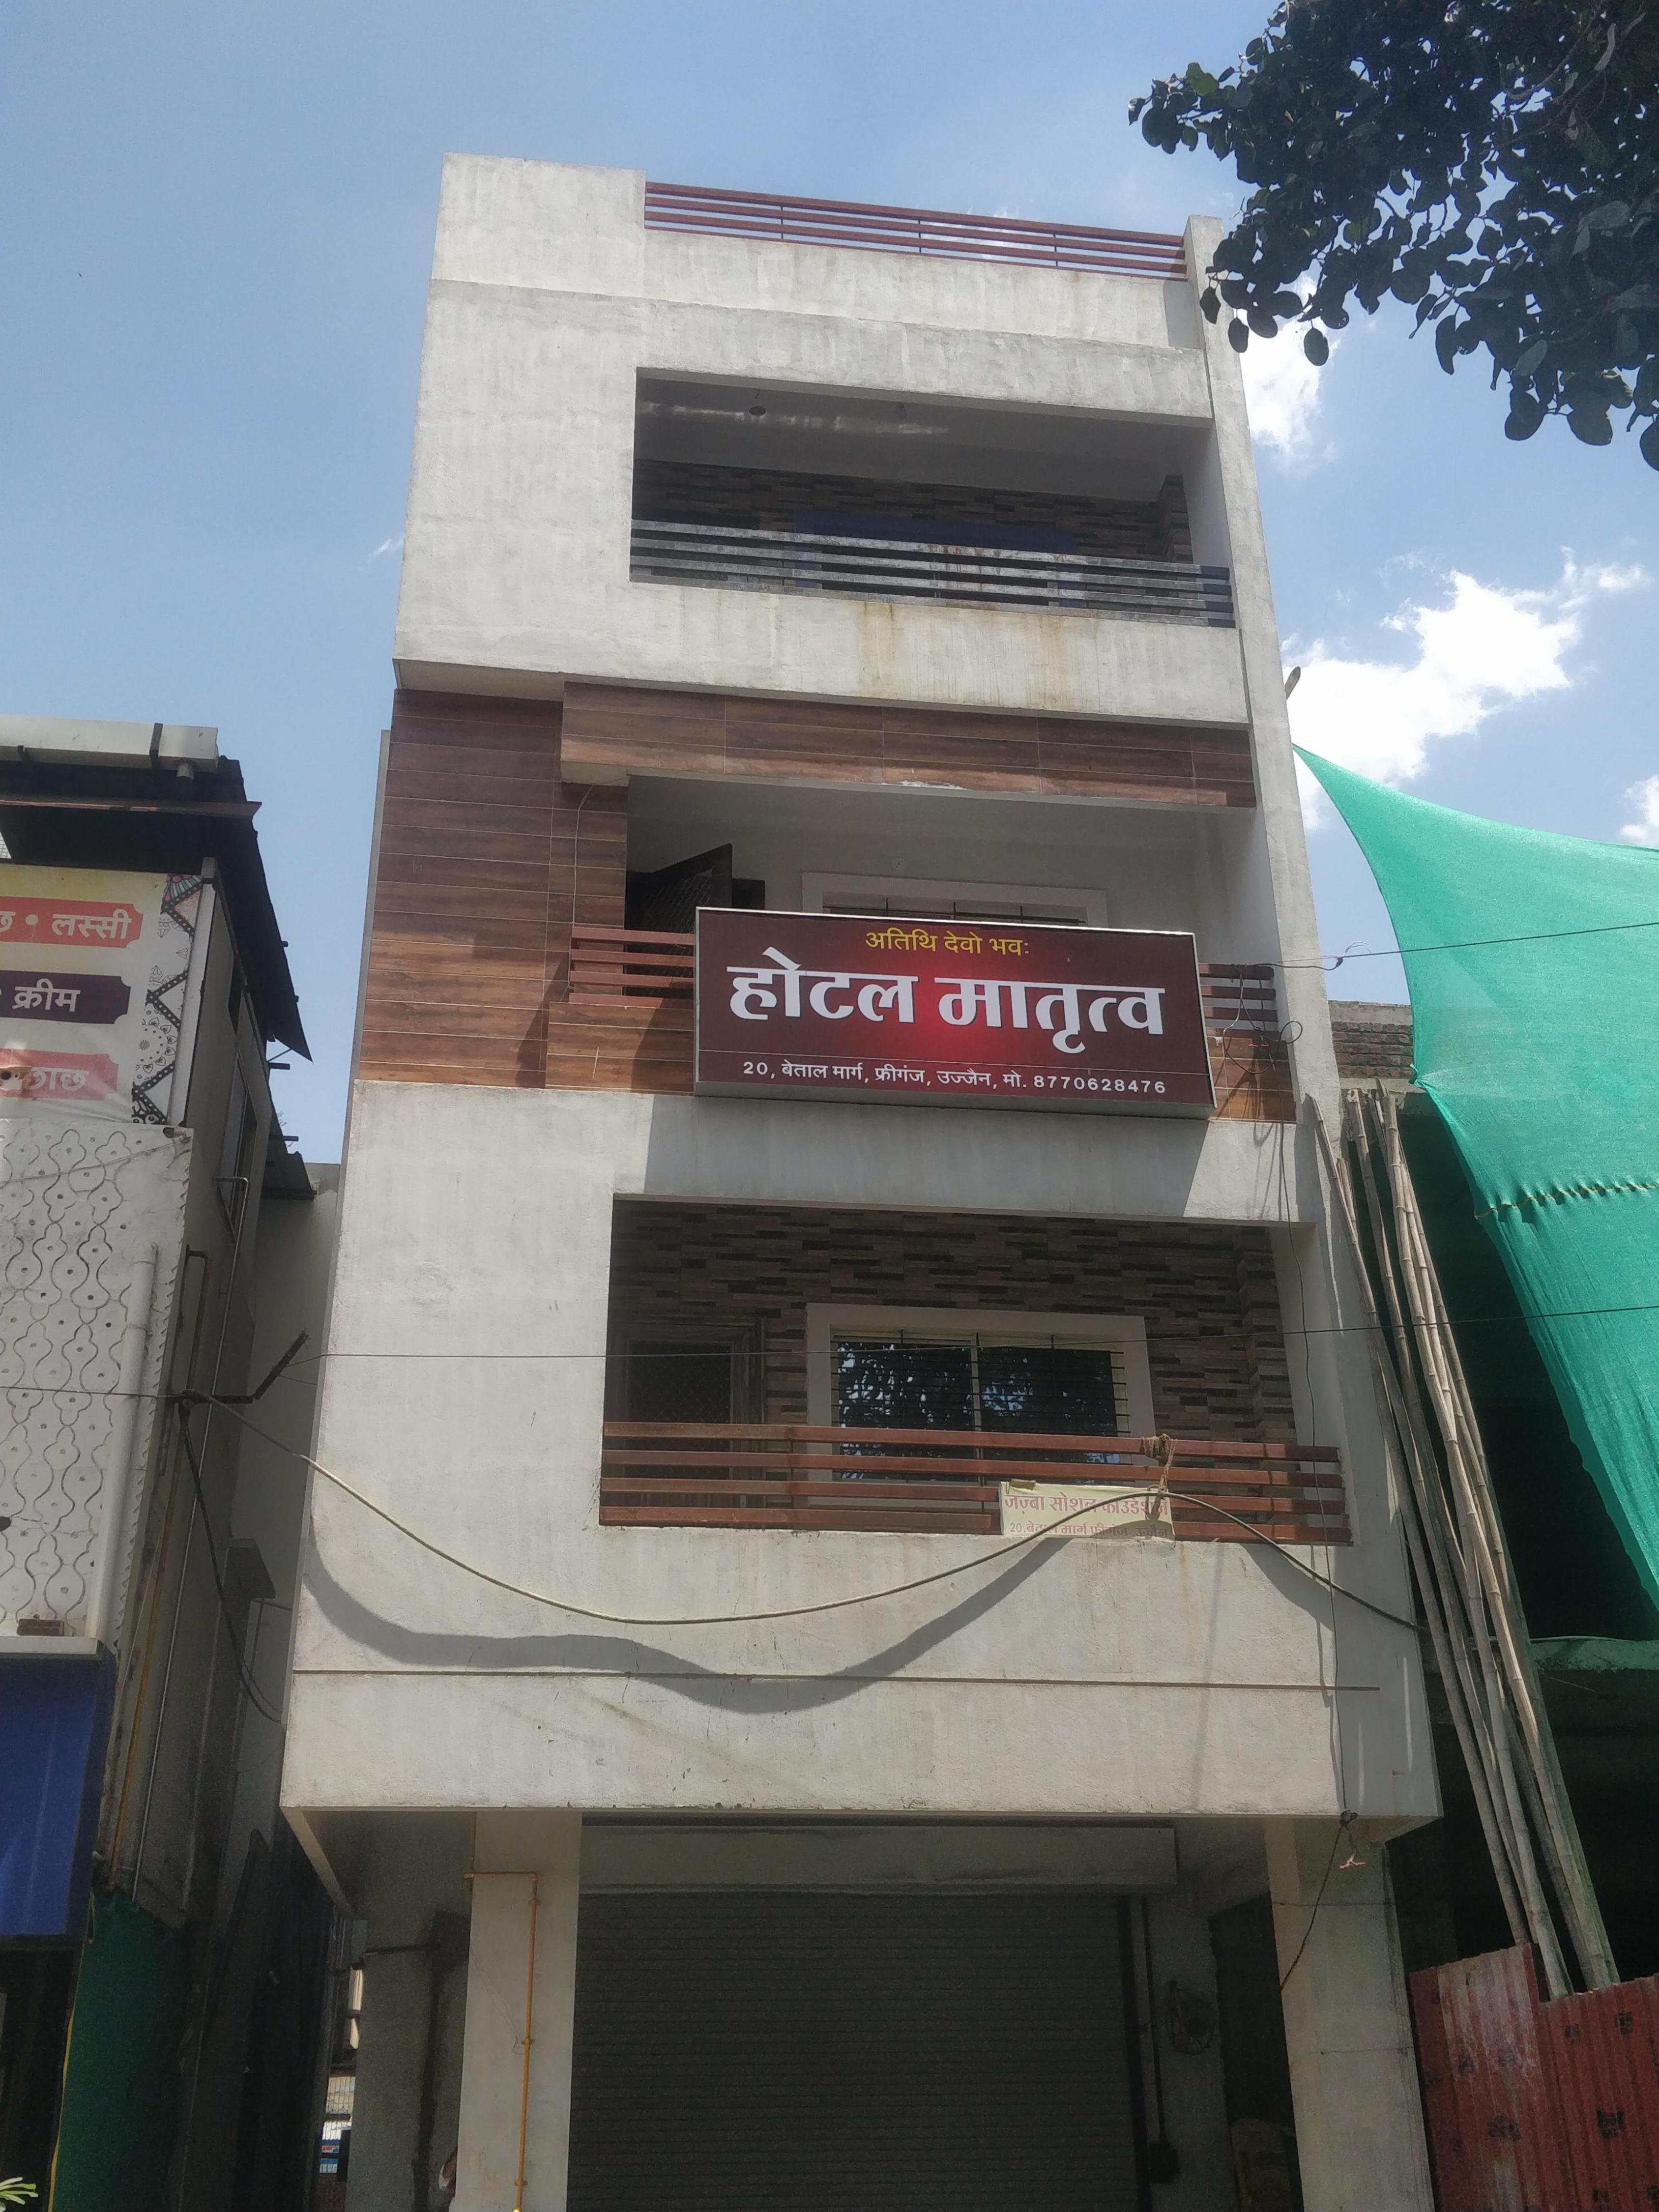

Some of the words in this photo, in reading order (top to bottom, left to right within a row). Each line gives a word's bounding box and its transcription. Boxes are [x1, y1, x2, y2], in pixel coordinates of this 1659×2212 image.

[52, 908, 132, 939] लस्सी
[865, 927, 938, 952] अतिथि
[943, 930, 983, 954] देवो
[11, 978, 82, 1013] क्रीम
[726, 946, 918, 1024] होटल
[934, 976, 1165, 1054] मातृत्व
[743, 1061, 776, 1079] 20,
[781, 1059, 828, 1078] बेताल
[832, 1062, 869, 1083] मार्ग,
[874, 1063, 931, 1086] फ्रीगंज,
[936, 1067, 997, 1090] उज्जैन,
[1002, 1069, 1027, 1088] मो.
[1033, 1075, 1166, 1094] 8770628476
[1048, 1491, 1097, 1513] सोशल
[1061, 1522, 1088, 1535] मार्ग
